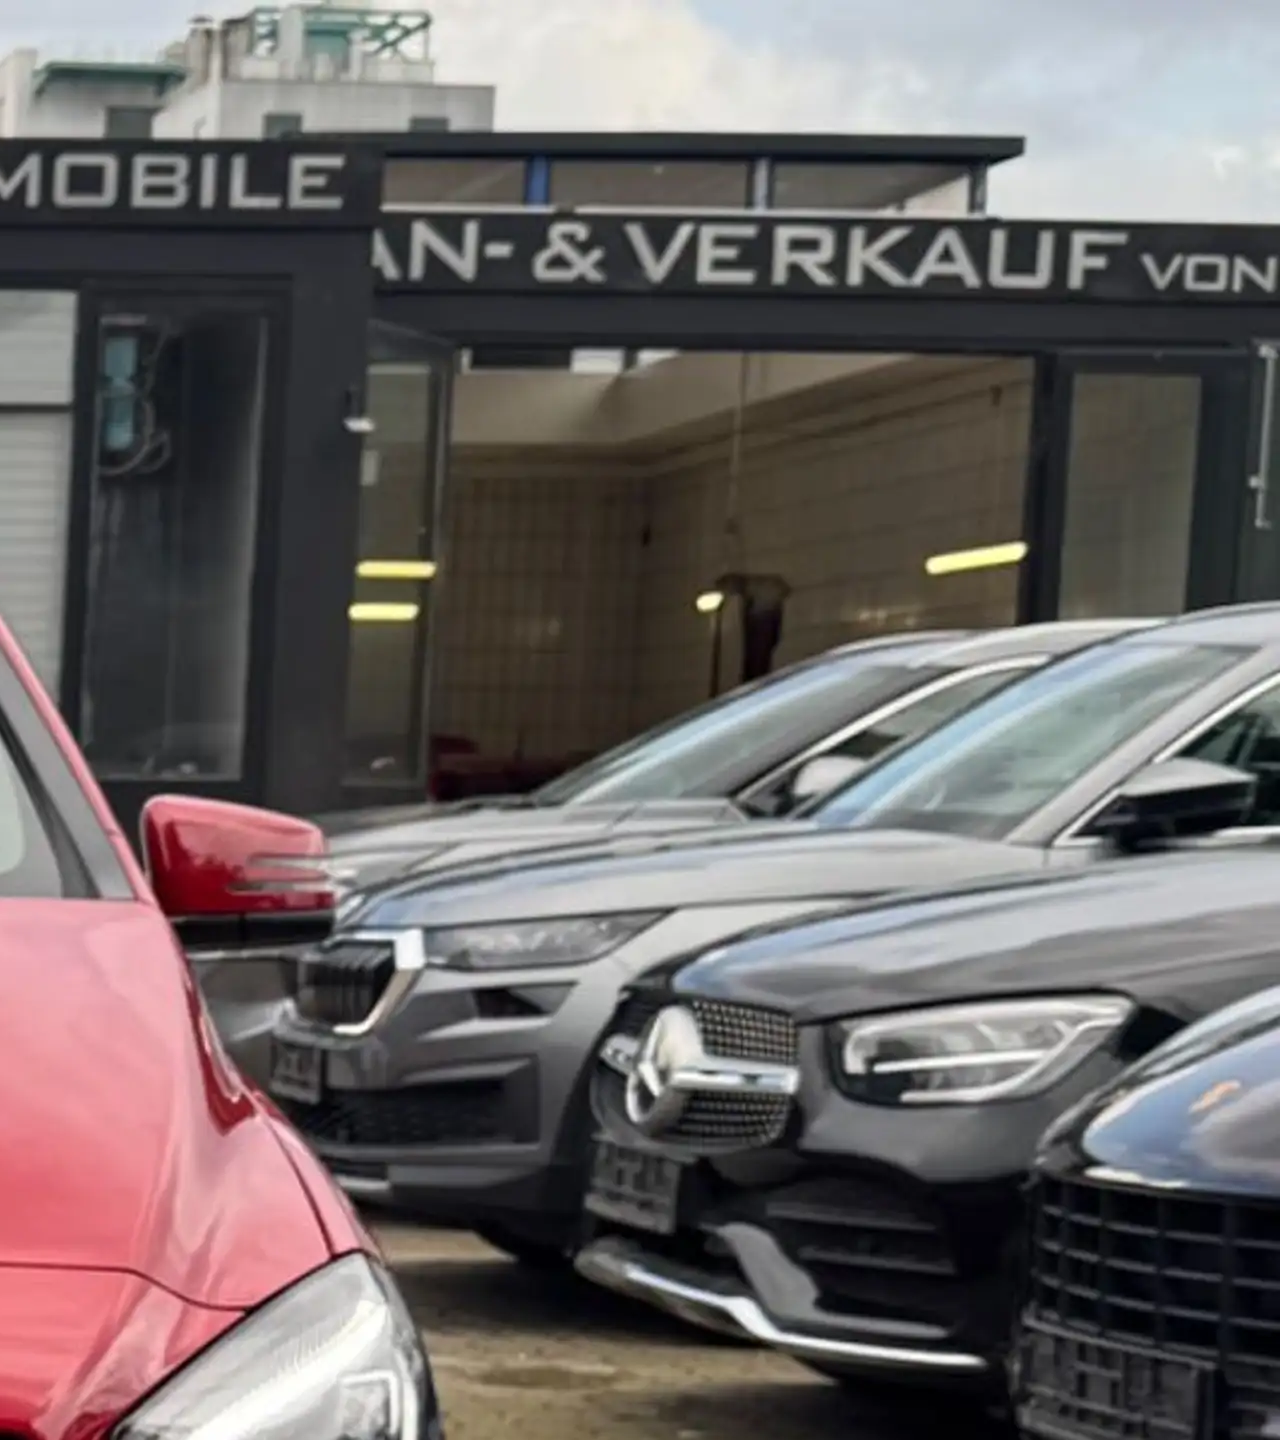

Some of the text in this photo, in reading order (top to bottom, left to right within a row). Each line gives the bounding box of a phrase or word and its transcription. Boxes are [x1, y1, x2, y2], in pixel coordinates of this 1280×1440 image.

[532, 221, 606, 283] &
[624, 223, 1129, 290] VERKAUF
[1140, 252, 1278, 293] VON
